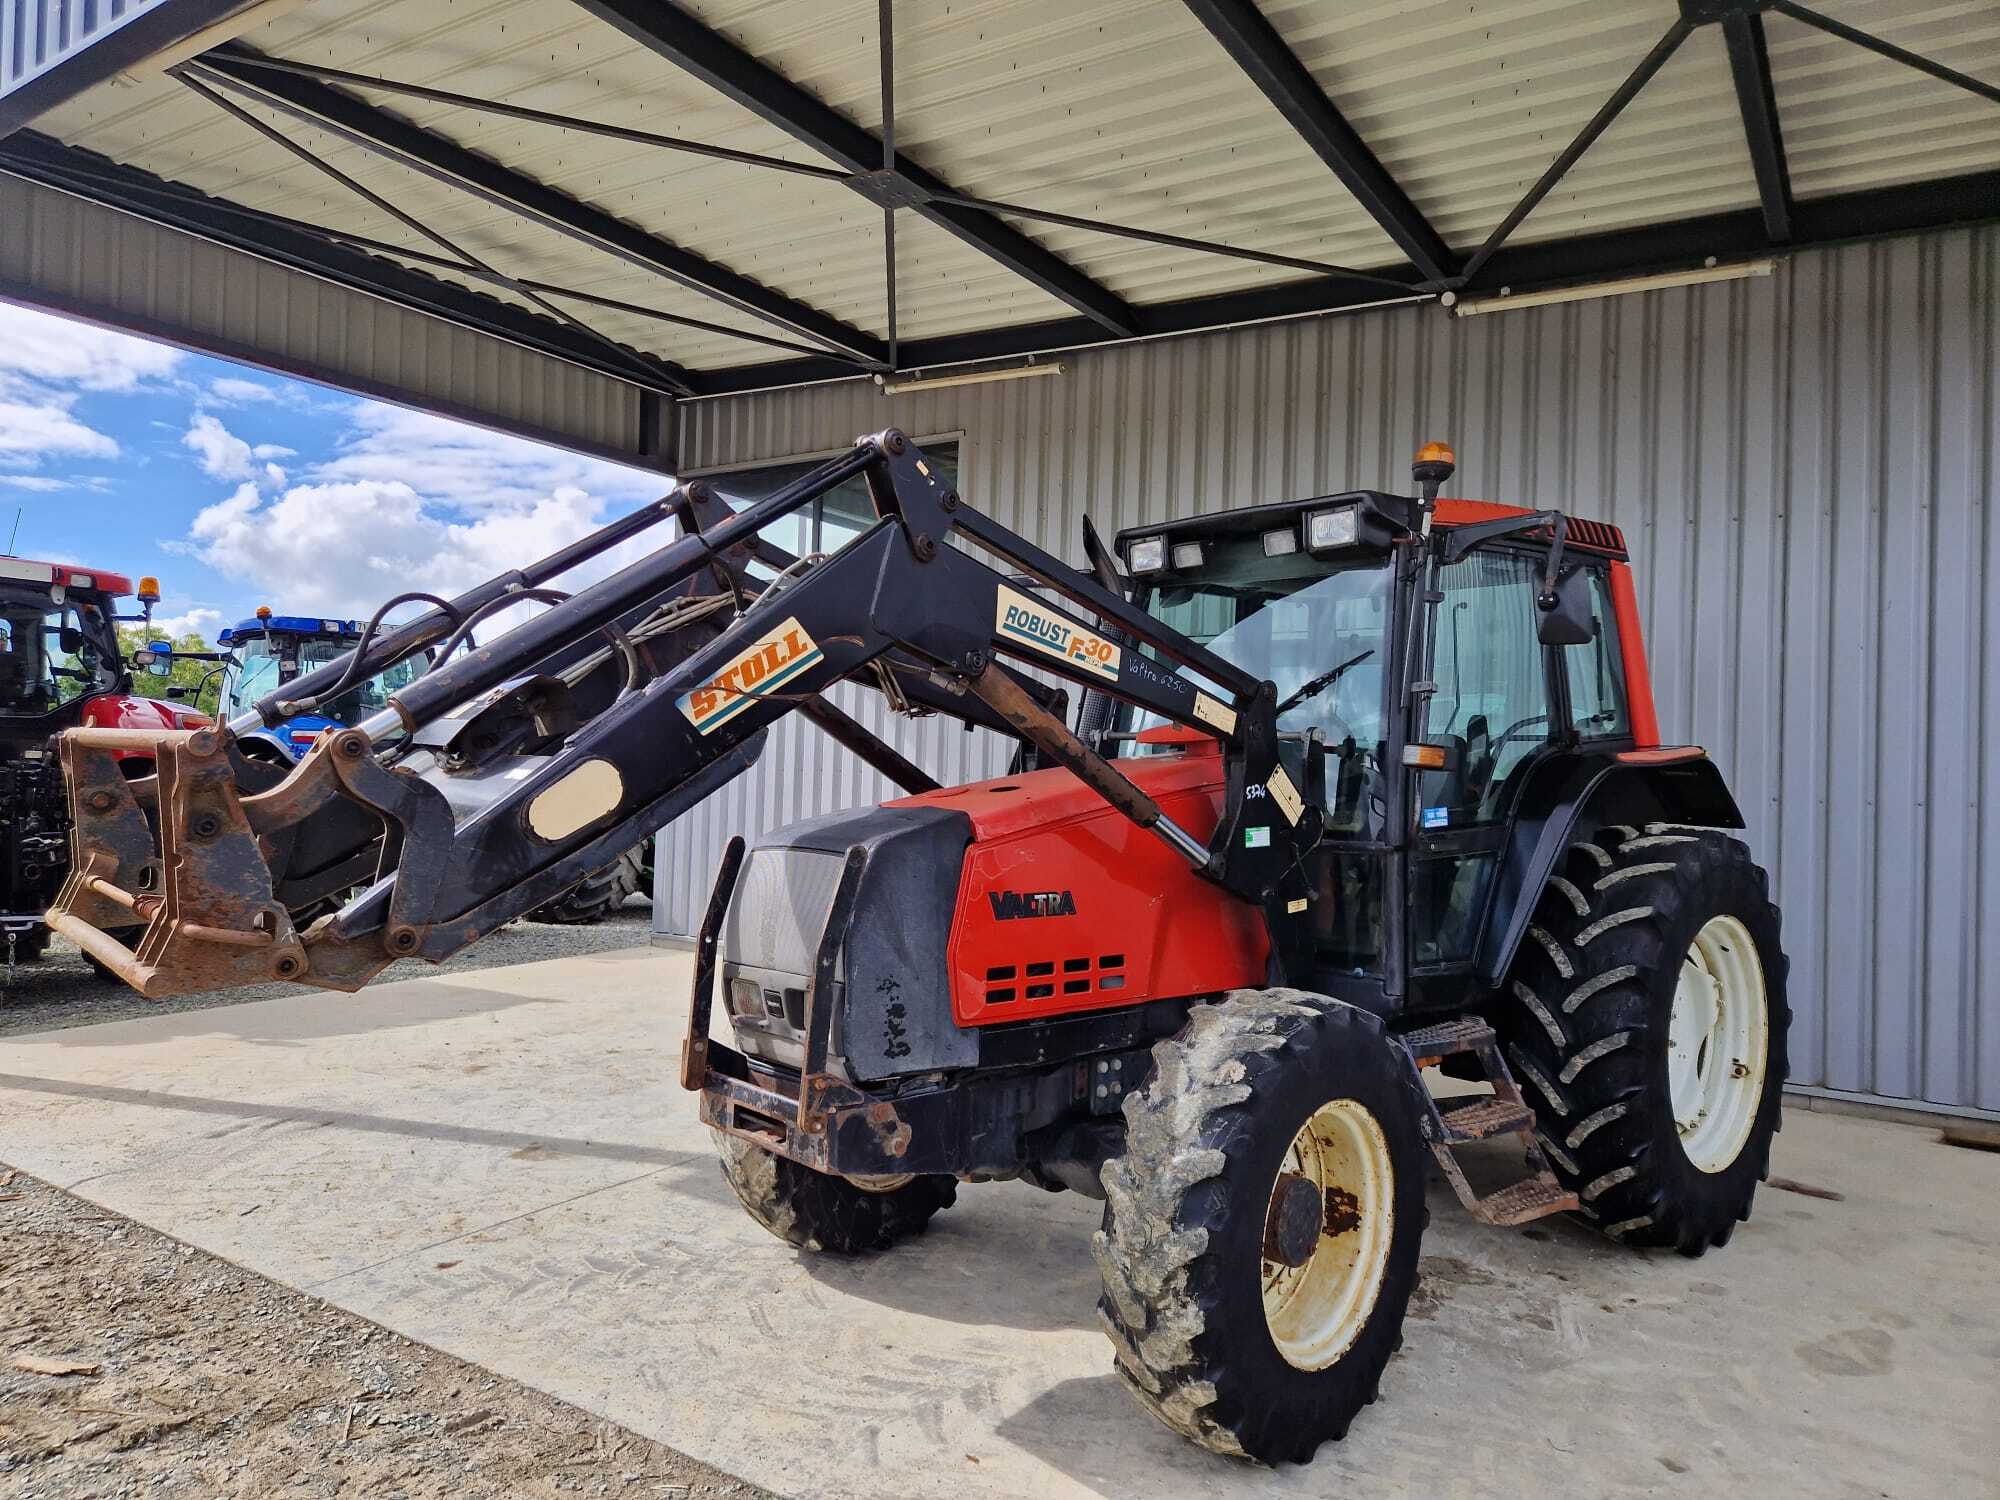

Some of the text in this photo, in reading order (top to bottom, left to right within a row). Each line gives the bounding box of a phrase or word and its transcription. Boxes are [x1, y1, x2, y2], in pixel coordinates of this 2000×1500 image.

[1005, 605, 1113, 662] ROBUST F30
[689, 629, 808, 720] STOLL
[988, 890, 1077, 920] VALTRA
